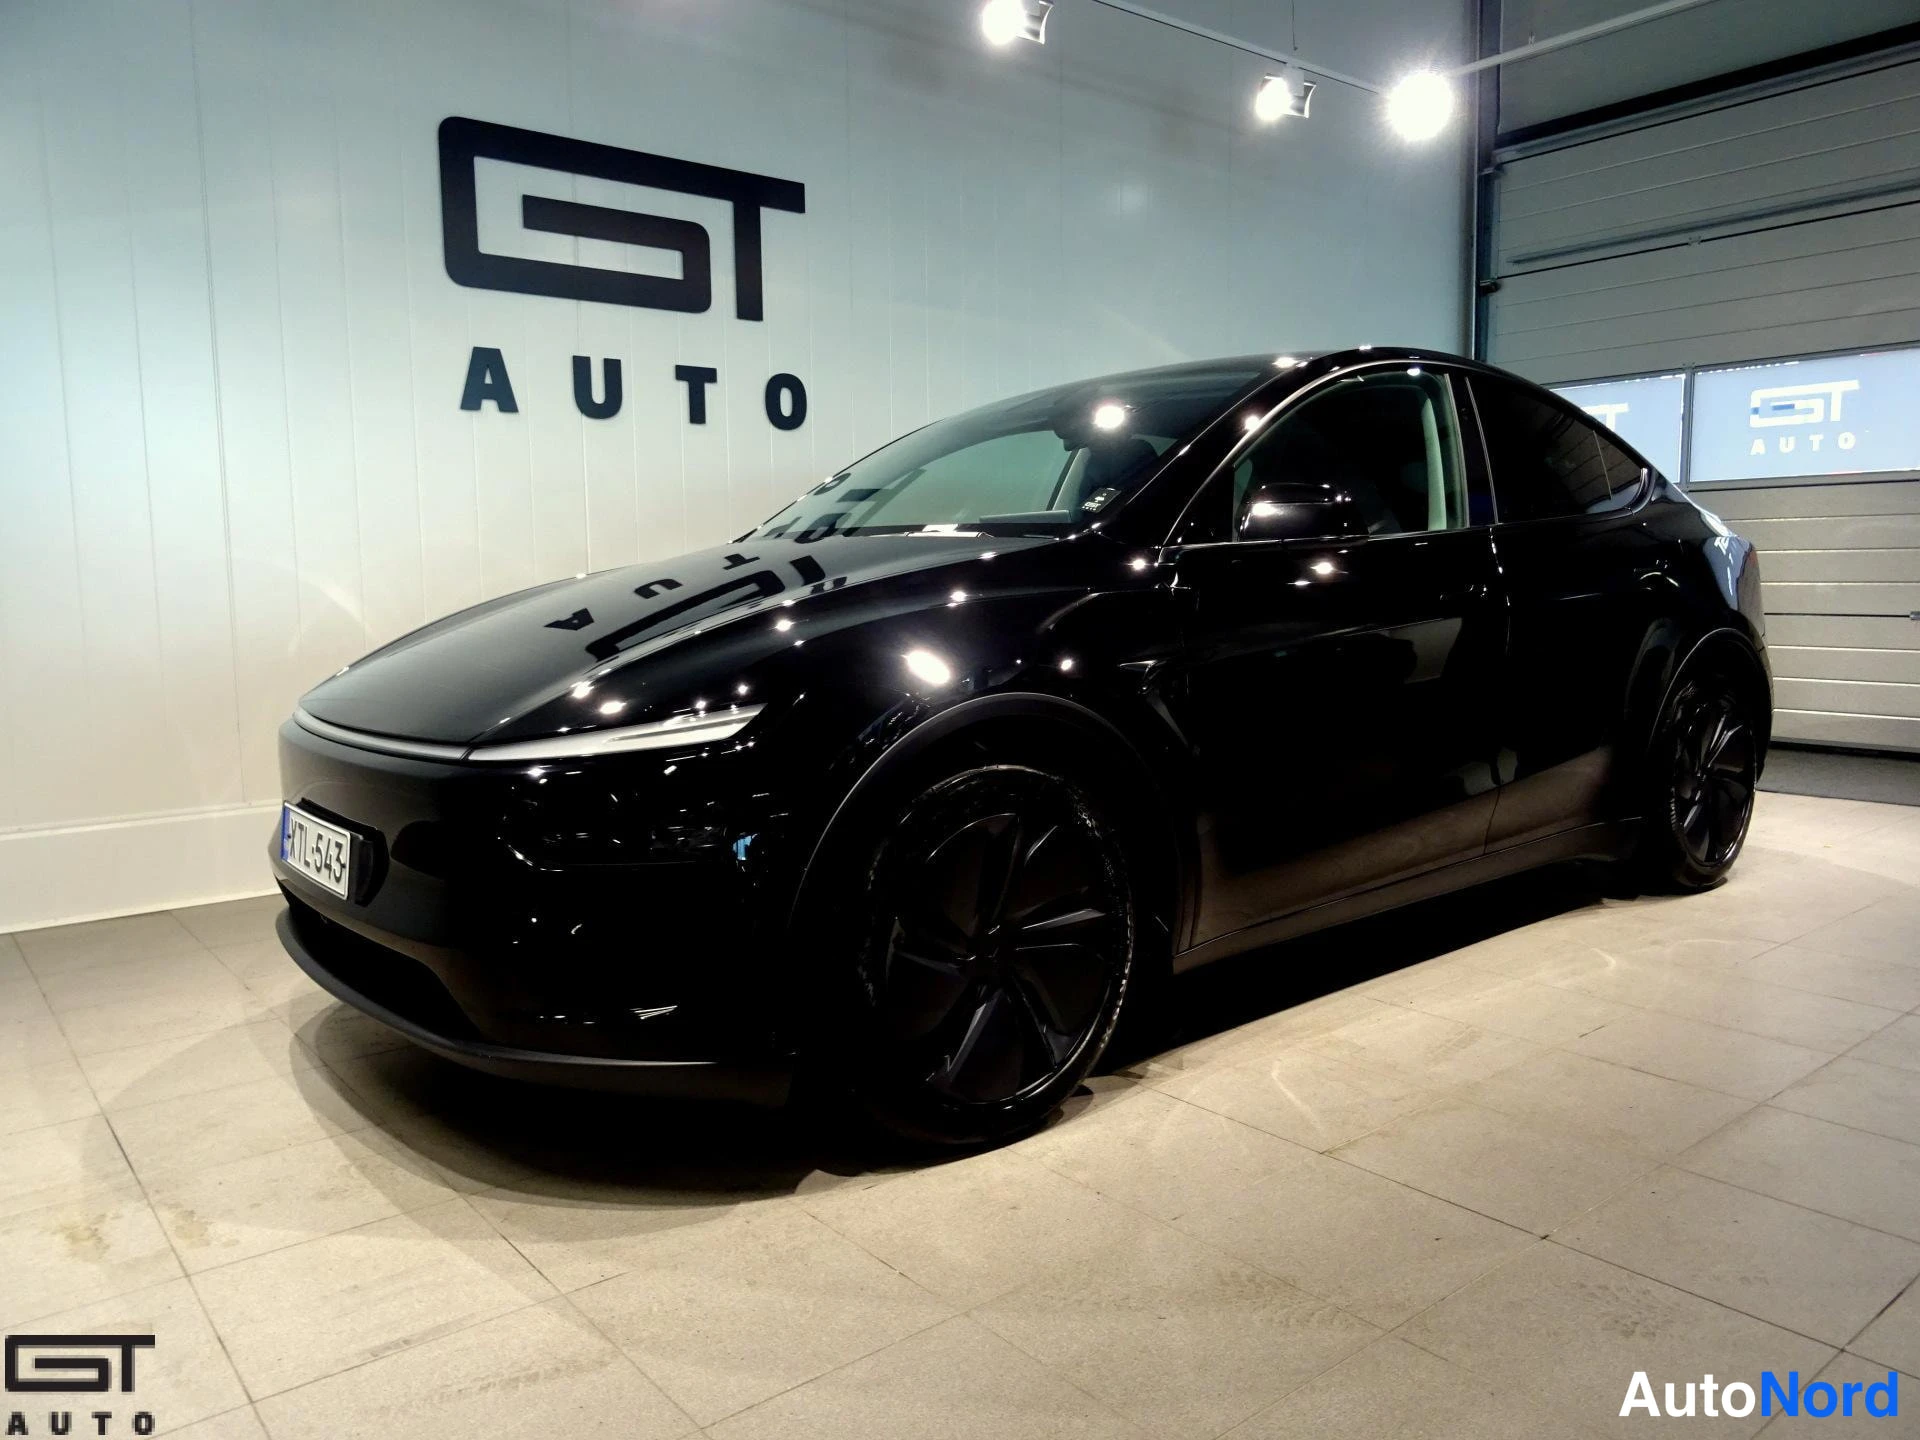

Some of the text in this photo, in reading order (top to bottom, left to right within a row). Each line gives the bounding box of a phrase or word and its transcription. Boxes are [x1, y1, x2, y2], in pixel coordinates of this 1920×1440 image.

[439, 115, 806, 322] GT
[460, 346, 808, 431] AUTO
[1750, 380, 1860, 428] GT
[1750, 432, 1856, 456] AUTO
[289, 818, 344, 884] XTL-543
